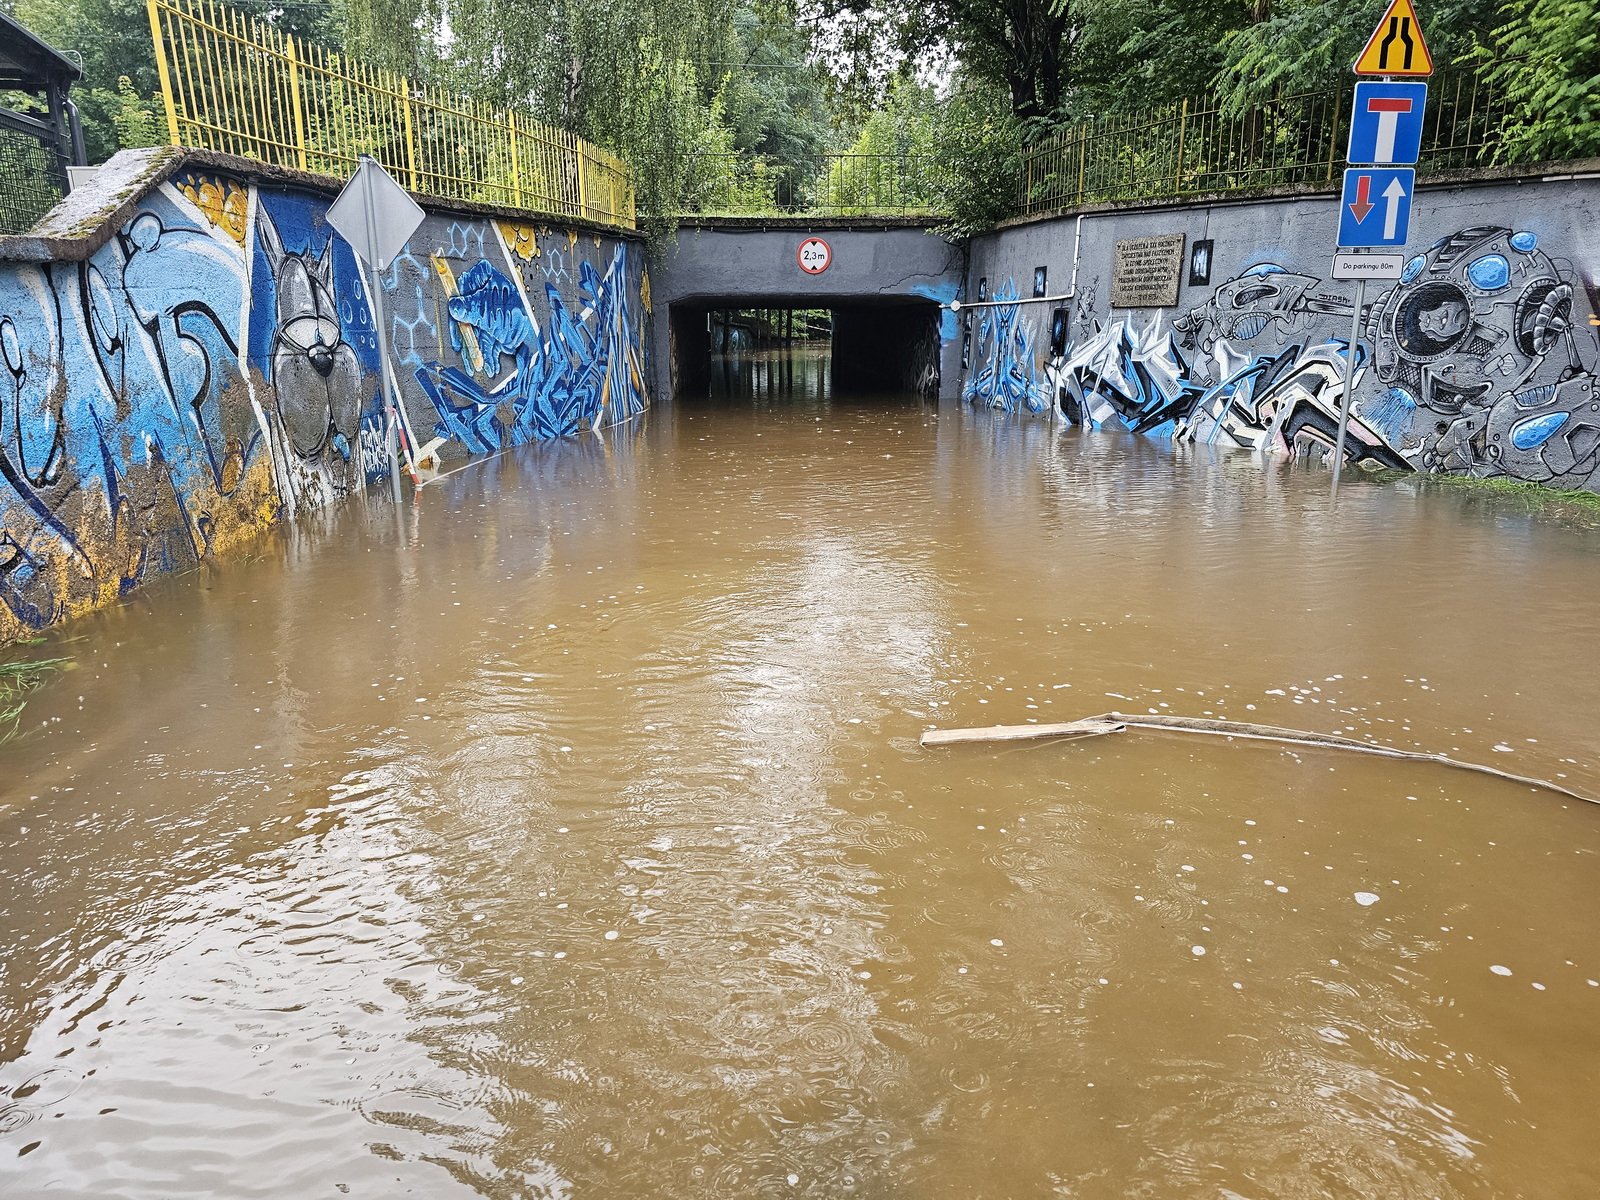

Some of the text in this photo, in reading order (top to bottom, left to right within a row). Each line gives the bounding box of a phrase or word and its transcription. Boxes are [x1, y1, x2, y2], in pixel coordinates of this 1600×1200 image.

[1343, 262, 1394, 272] Do parkingu 80m
